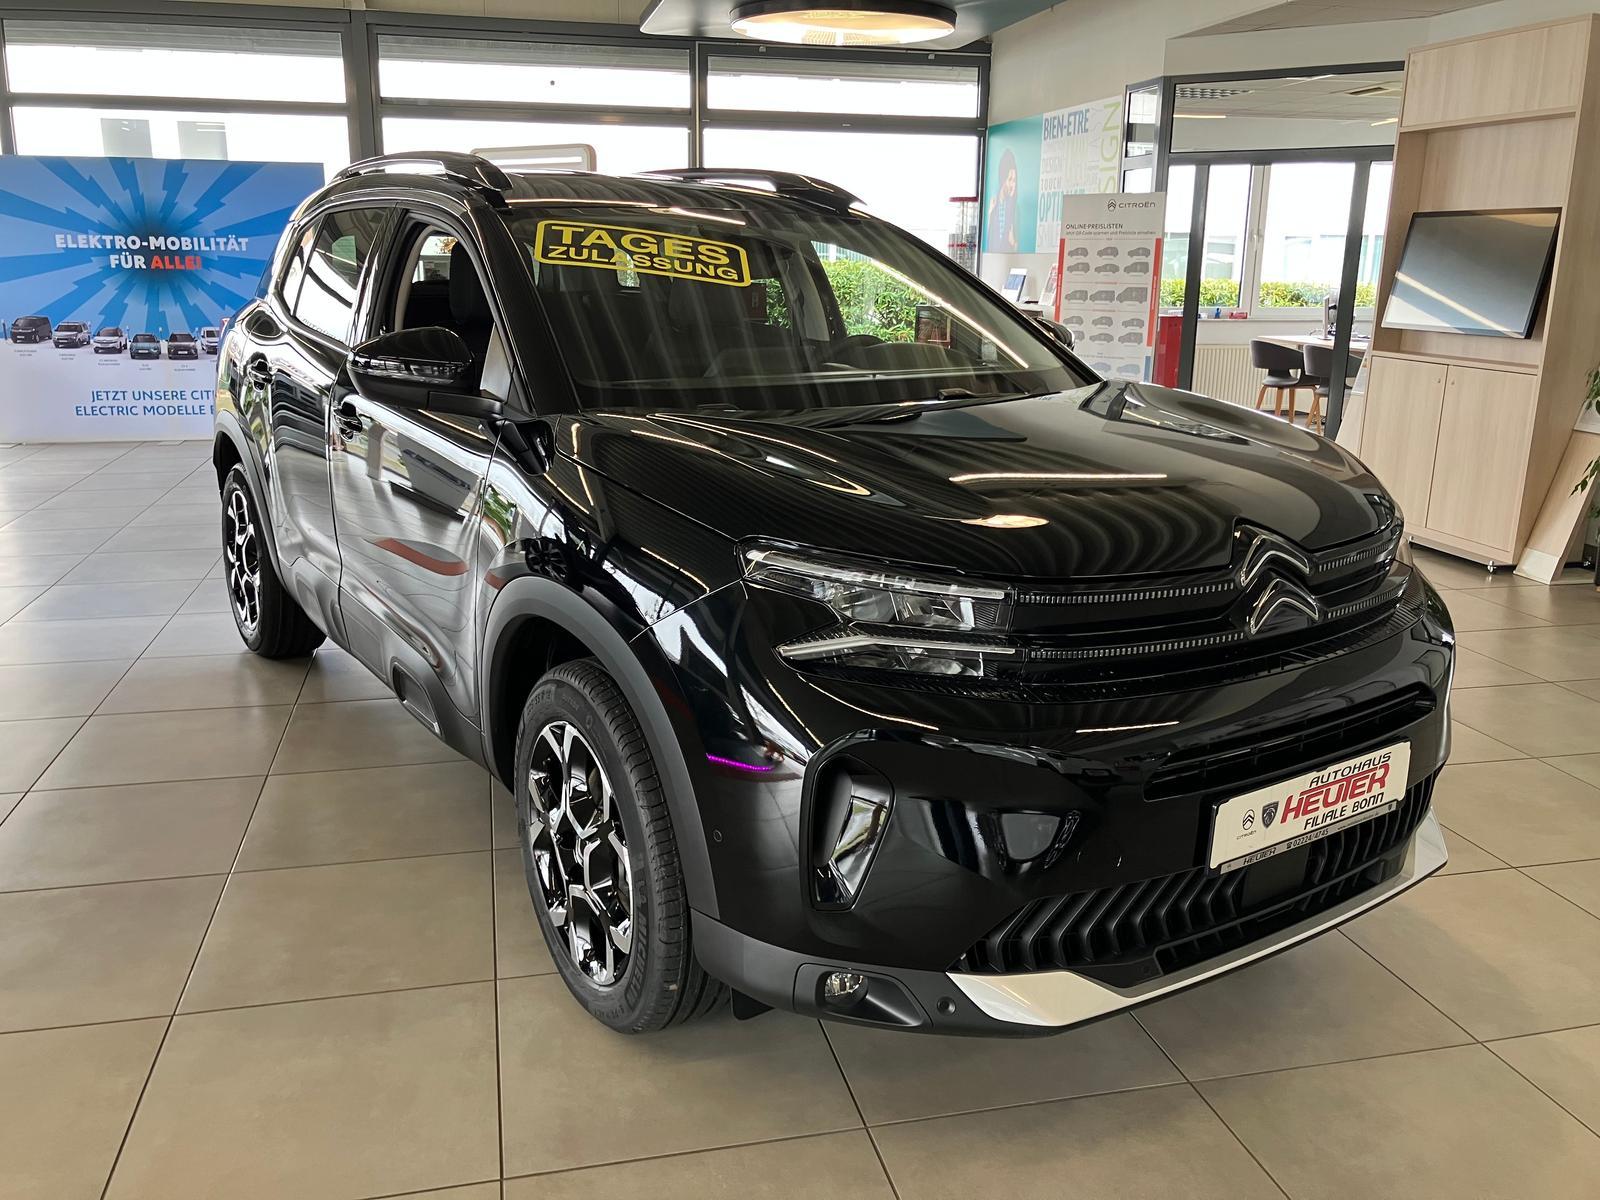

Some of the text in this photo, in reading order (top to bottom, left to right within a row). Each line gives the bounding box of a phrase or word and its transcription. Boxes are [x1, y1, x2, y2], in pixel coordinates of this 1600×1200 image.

[1043, 108, 1090, 141] BIEN-ETRE
[55, 234, 248, 252] ELEKTRO-MOBILITÄT
[551, 225, 730, 265] TAGES
[109, 252, 202, 270] FÜR ALLE!
[547, 245, 738, 280] ZULASSUNG
[75, 405, 139, 416] ELECTRIC
[143, 405, 206, 416] MODELLE
[91, 390, 127, 402] JETZT
[132, 390, 186, 401] UNSERE
[1309, 752, 1391, 788] AUTOHAUS
[1304, 806, 1347, 830] FILIALE
[1352, 792, 1384, 813] BONN
